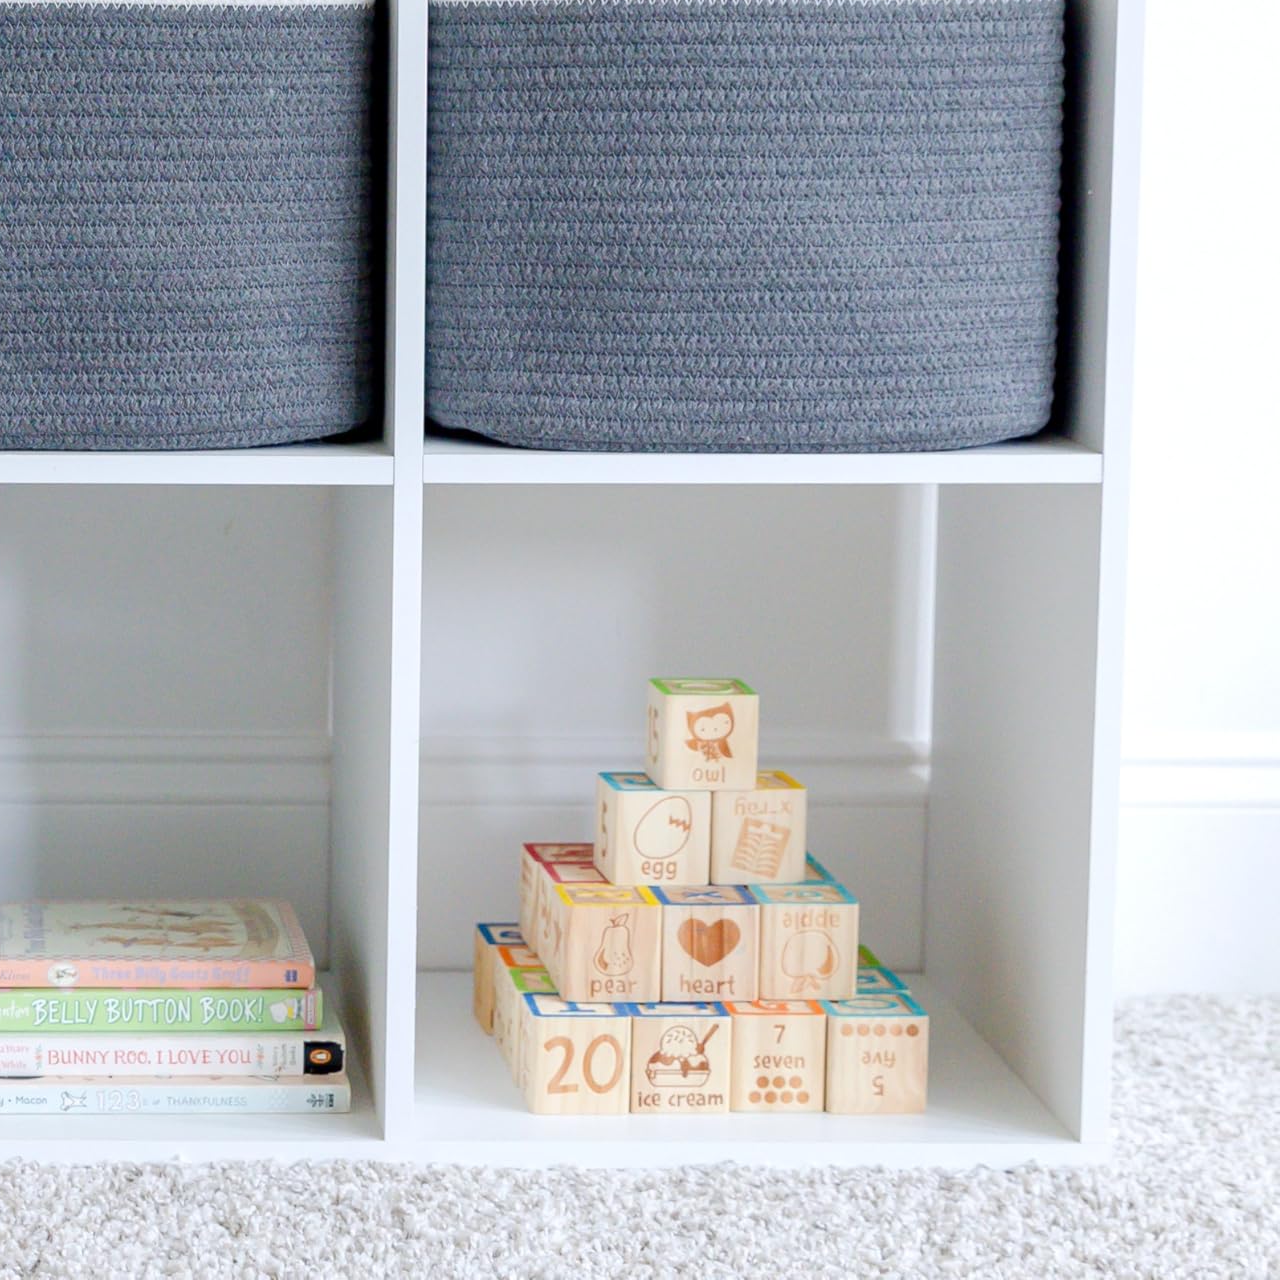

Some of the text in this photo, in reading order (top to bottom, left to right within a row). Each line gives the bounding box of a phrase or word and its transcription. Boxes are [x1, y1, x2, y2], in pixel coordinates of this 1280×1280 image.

[691, 766, 726, 783] owl
[641, 860, 678, 880] egg
[782, 909, 841, 930] apple
[590, 977, 638, 998] pear
[680, 975, 735, 996] heart
[31, 995, 264, 1026] BELLY BUTTON BOOK!
[773, 1024, 786, 1044] 7
[47, 1049, 110, 1065] BUNNY
[158, 1050, 164, 1065] I
[169, 1049, 212, 1065] LOVE
[215, 1049, 253, 1065] YOU
[543, 1034, 623, 1095] 20
[753, 1054, 806, 1070] seven
[861, 1050, 896, 1068] five
[873, 1075, 885, 1097] 5
[15, 1095, 48, 1106] Macon
[167, 1095, 249, 1107] THANKFULNESS
[637, 1091, 724, 1108] ice cream
